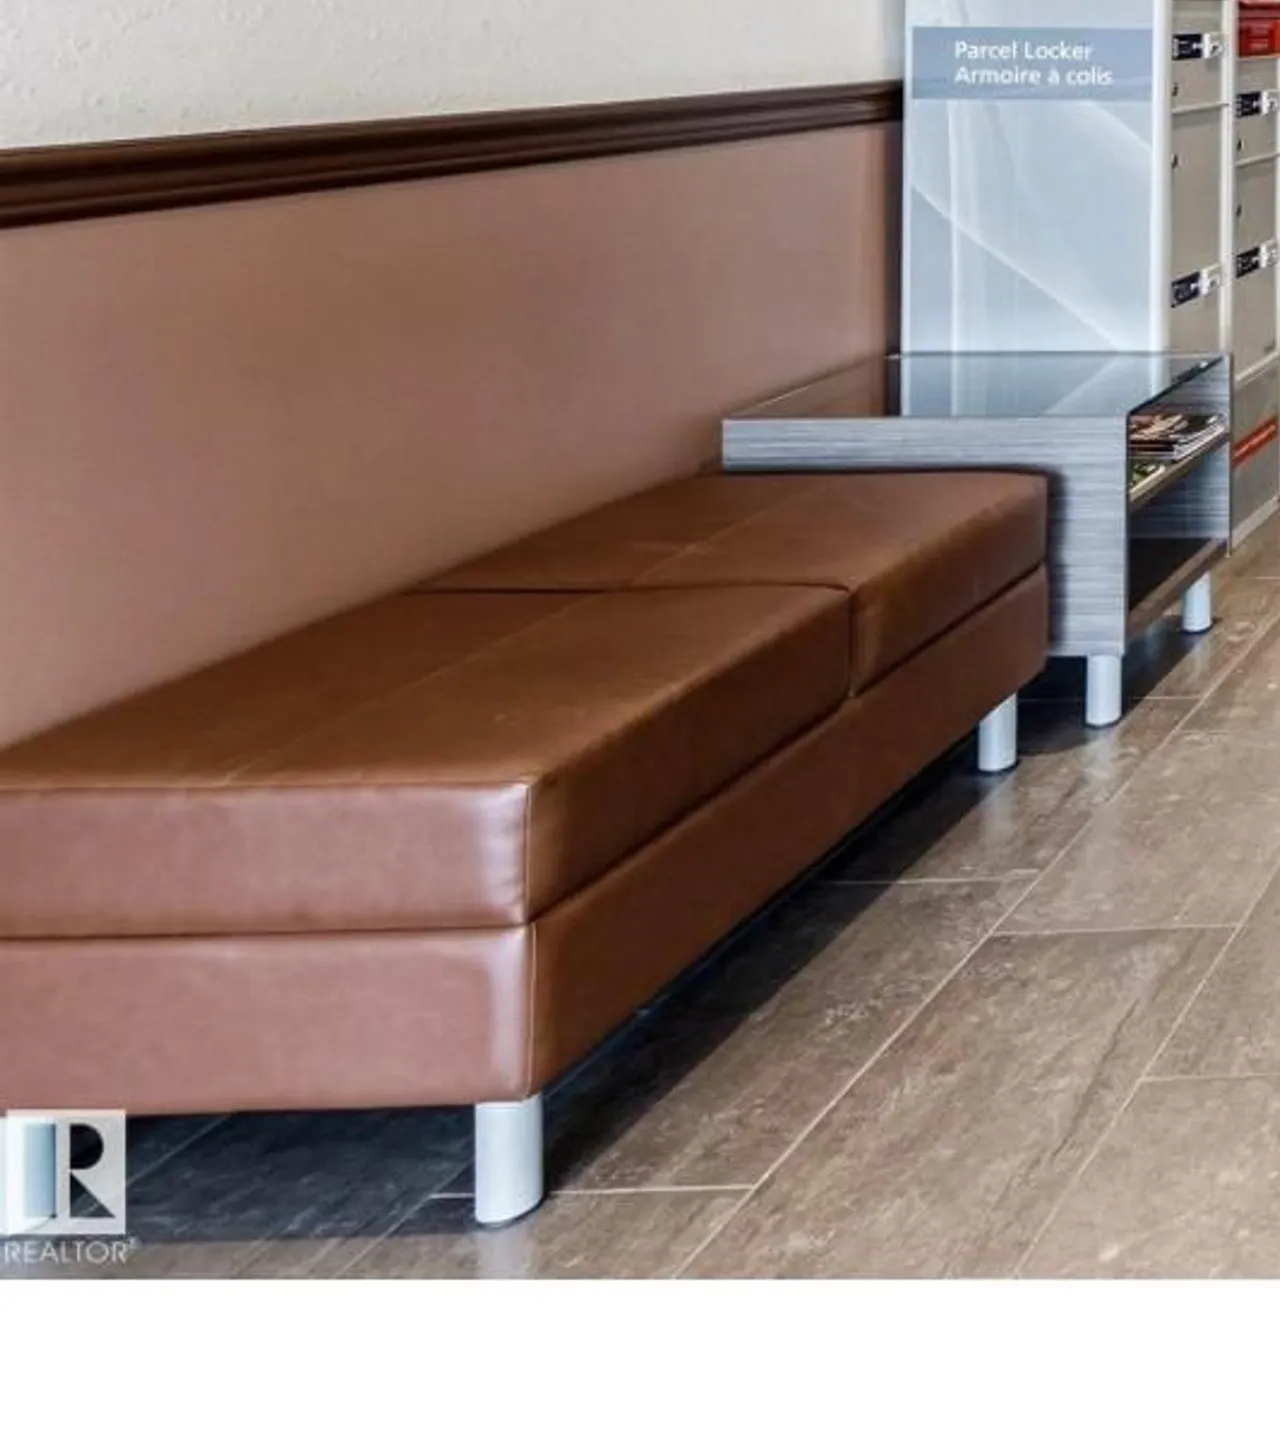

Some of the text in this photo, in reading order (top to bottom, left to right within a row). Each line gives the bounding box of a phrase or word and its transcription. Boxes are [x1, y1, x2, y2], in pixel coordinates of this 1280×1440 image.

[954, 40, 1094, 61] Parcel Locker
[953, 65, 1042, 86] Armoire
[1065, 65, 1114, 87] colis
